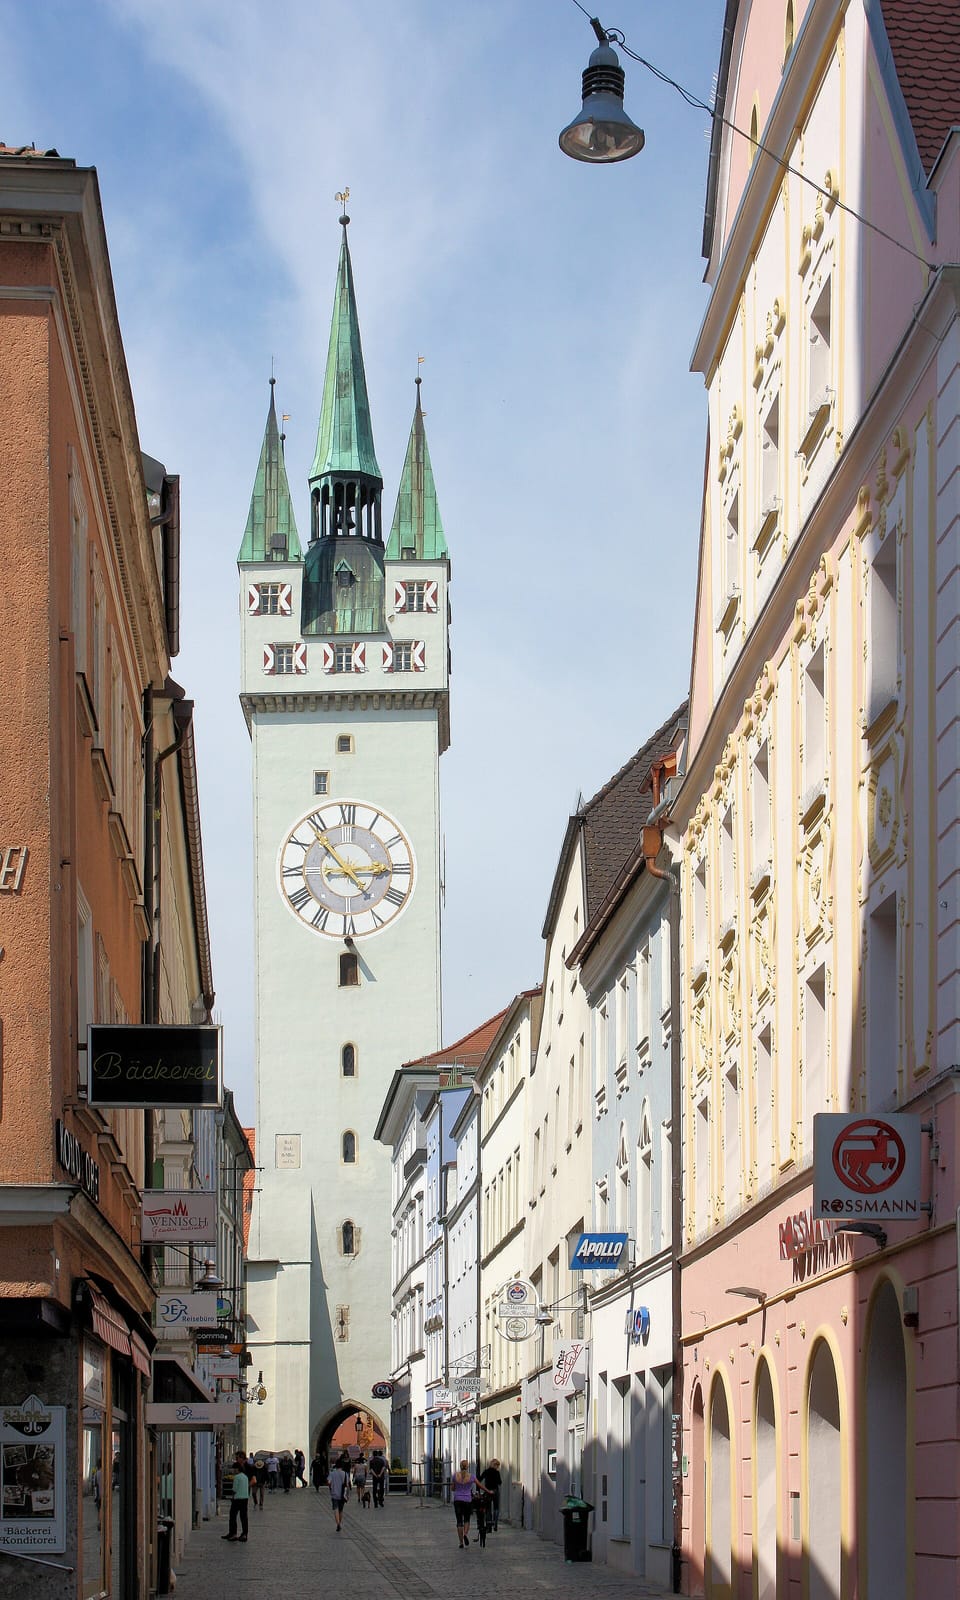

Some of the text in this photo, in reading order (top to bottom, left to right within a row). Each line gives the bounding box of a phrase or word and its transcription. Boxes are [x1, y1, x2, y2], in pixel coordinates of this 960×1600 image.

[338, 805, 356, 825] XII
[287, 833, 311, 853] X
[0, 846, 27, 890] EI
[391, 863, 411, 875] III
[342, 914, 357, 935] VI
[370, 908, 385, 928] V
[93, 1051, 215, 1080] Bäckerei
[821, 1199, 917, 1213] ROSSMANN
[149, 1217, 207, 1227] WENISCH
[576, 1239, 623, 1257] APOLLO
[160, 1303, 188, 1316] DER
[5, 1526, 51, 1535] Bäckerei
[0, 1535, 57, 1545] Konditorei
